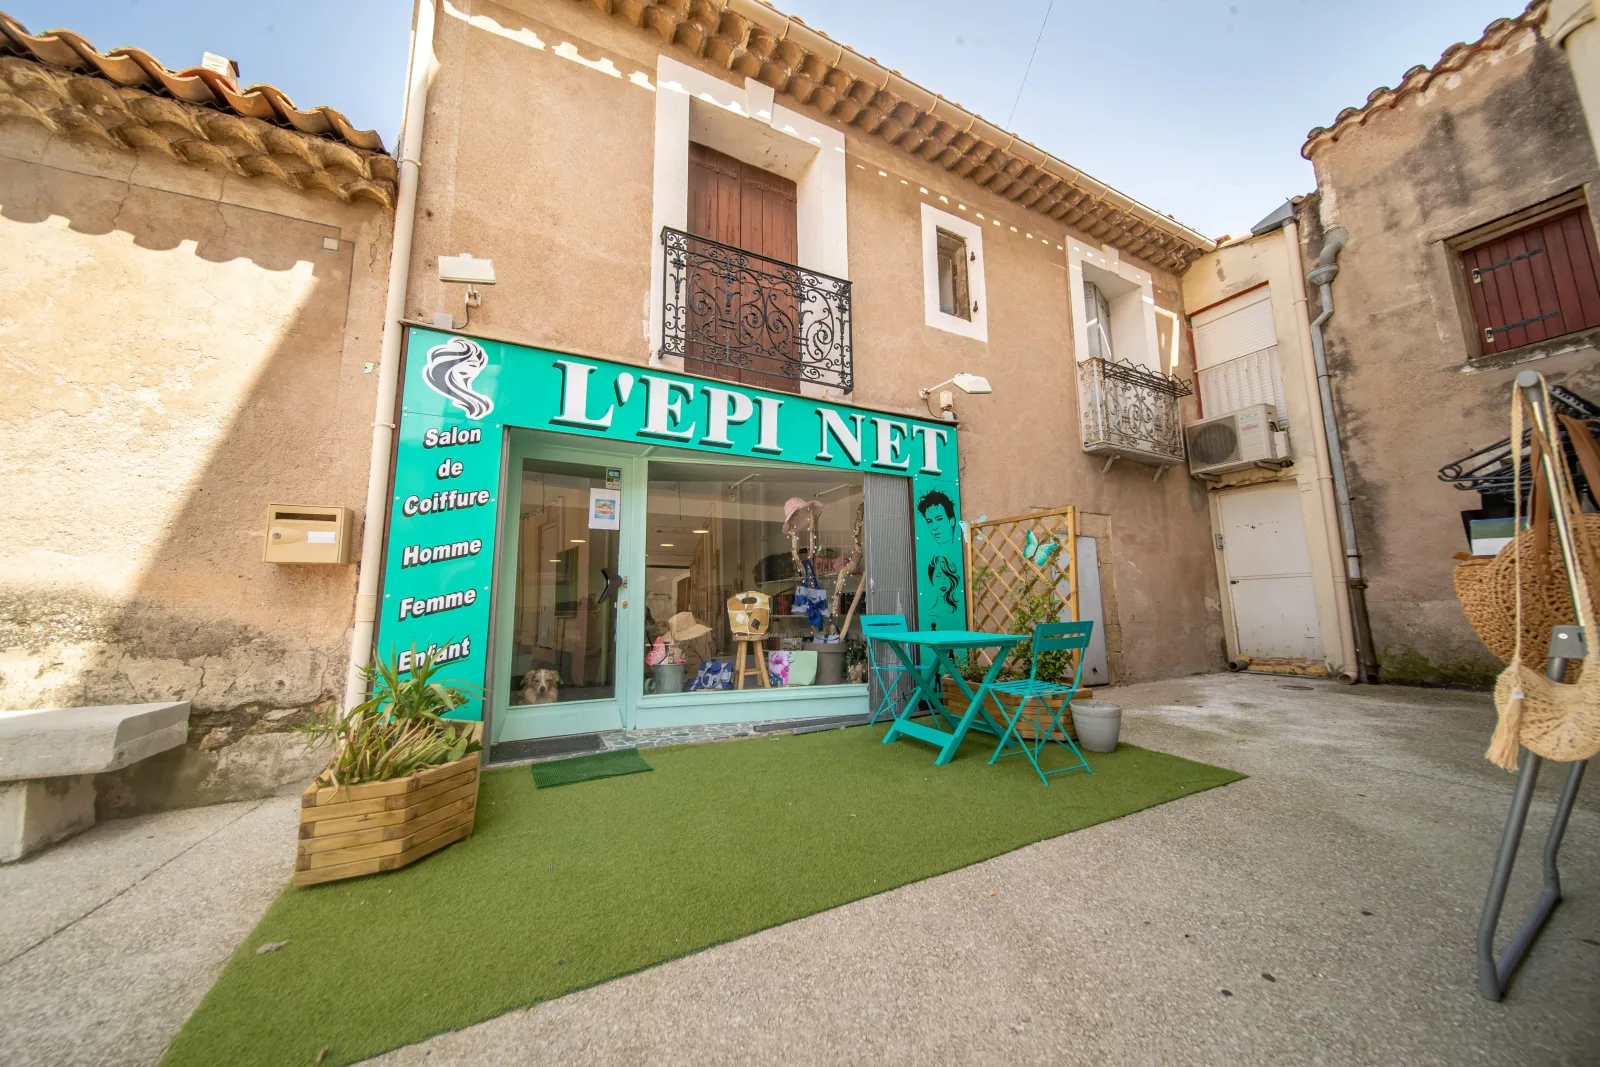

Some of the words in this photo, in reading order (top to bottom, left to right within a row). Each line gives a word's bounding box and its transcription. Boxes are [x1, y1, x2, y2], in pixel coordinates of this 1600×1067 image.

[550, 359, 785, 455] L'EPI
[816, 406, 948, 476] NET
[423, 426, 481, 449] Salon
[436, 458, 464, 480] de
[402, 489, 490, 517] Coiffure
[401, 538, 482, 569] Homme
[398, 588, 477, 621] Femme
